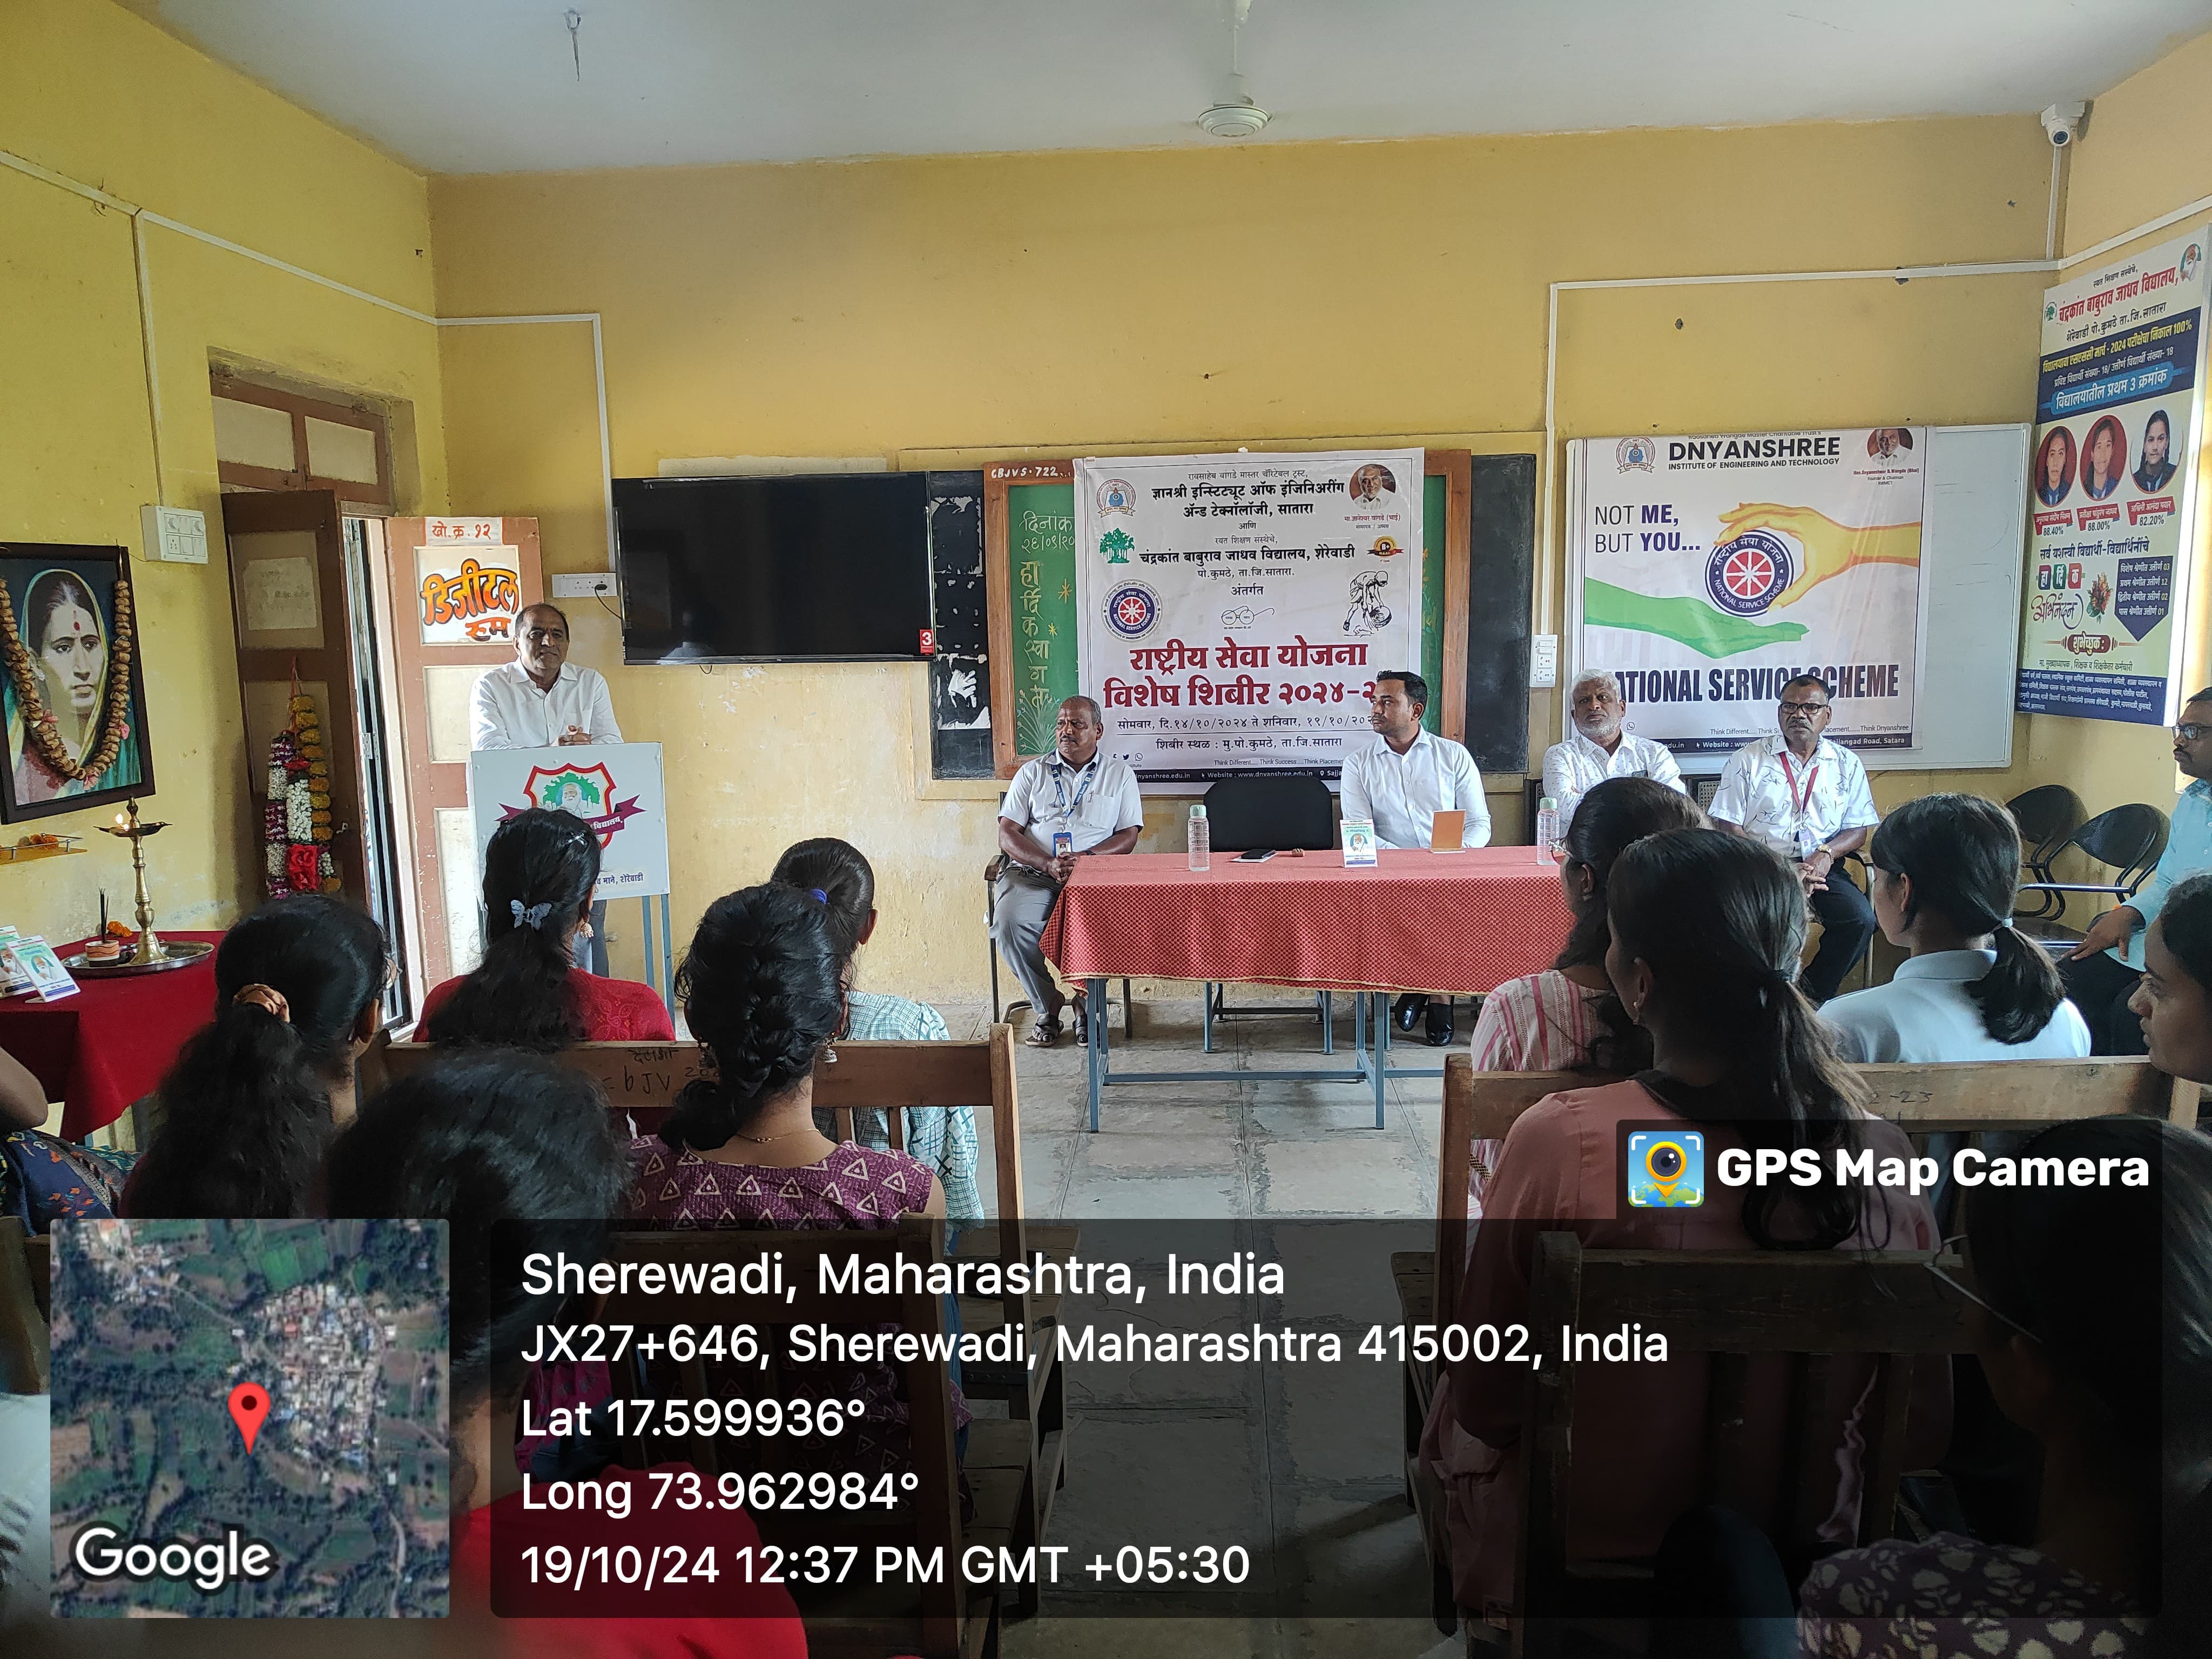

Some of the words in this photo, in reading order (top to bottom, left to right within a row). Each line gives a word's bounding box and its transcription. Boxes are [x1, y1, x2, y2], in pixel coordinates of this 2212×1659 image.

[2059, 295, 2085, 322] चंद्रकांत
[2087, 289, 2114, 316] बाबुराव
[2116, 280, 2139, 301] जाधव
[2141, 267, 2178, 294] विद्यालय,
[2067, 324, 2089, 341] शेरेवाडी
[2070, 346, 2094, 365] एसएससी
[2094, 342, 2106, 357] मार्च
[2110, 339, 2126, 353] 2024
[2150, 325, 2173, 341] निकाल
[2174, 318, 2191, 334] 100%
[2167, 347, 2173, 356] 18
[2056, 383, 2106, 409] विद्यालयातील
[2107, 380, 2128, 396] प्रथम
[2130, 377, 2135, 390] 3
[2139, 367, 2168, 388] क्रमांक
[1669, 436, 1840, 461] DNYANSHREE
[1188, 472, 1216, 480] रावसाहेब
[1292, 470, 1307, 478] ट्रस्ट,
[1152, 484, 1187, 500] ज्ञानश्री
[1191, 482, 1245, 500] इन्स्टिट्यूट
[1250, 481, 1276, 495] ऑफ
[1280, 479, 1345, 497] इंजिनिअरींग
[1211, 501, 1272, 517] टेक्नॉलॉजी,
[1277, 504, 1313, 515] सातारा
[1596, 505, 1634, 525] NOT
[1642, 504, 1678, 526] ME,
[1019, 510, 1075, 535] दिनांक
[1239, 521, 1256, 529] आणि
[2088, 521, 2109, 531] 88.00%
[2140, 514, 2164, 525] 82.20%
[475, 523, 491, 539] १२
[1231, 535, 1251, 544] शिक्षण
[1254, 534, 1277, 543] संस्थेचे,
[2044, 526, 2063, 536] 88.40%
[1596, 534, 1633, 552] BUT
[1640, 532, 1700, 551] YOU...
[1740, 536, 1759, 548] सेवा
[1762, 541, 1783, 564] योजना
[1139, 549, 1179, 565] चंद्रकांत
[1183, 551, 1221, 567] बाबुराव
[1225, 550, 1257, 561] जाधव
[1260, 545, 1310, 561] विद्यालय,
[1314, 544, 1355, 559] शेरेवाडी
[2040, 544, 2051, 559] सर्व
[1197, 567, 1234, 580] पो.कुमठे,
[420, 558, 519, 626] डिजीटल
[1231, 583, 1264, 595] अंतर्गत
[1714, 579, 1737, 608] NATIONAL
[1737, 599, 1765, 609] SERVICE
[1764, 578, 1785, 601] SCHEME
[1114, 613, 1125, 629] NATIONAL
[1141, 613, 1151, 627] SCHEME
[922, 631, 933, 646] 3
[1130, 638, 1209, 676] राष्ट्रीय
[1216, 636, 1270, 669] सेवा
[1277, 635, 1368, 666] योजना
[2074, 659, 2088, 669] शिक्षक
[2115, 660, 2133, 671] कर्मचारी
[1103, 676, 1181, 708] विशेष
[1188, 675, 1270, 705] शिबीर
[1279, 682, 1375, 704] २०२४-२
[1615, 670, 1702, 703] ATIONAL
[1709, 666, 1802, 702] SERVIC
[1809, 664, 1899, 699] CHEME
[1117, 718, 1154, 730] सोमवार,
[1159, 718, 1247, 730] दि.१४/१०/२०२४
[1251, 716, 1258, 726] ते
[1263, 716, 1300, 727] शनिवार,
[1307, 715, 1371, 727] १९/१०/२०२
[1877, 724, 1909, 732] Dnyanshree
[1156, 738, 1183, 750] शिबीर
[1187, 740, 1210, 749] स्थळ
[1222, 736, 1276, 751] मु.पो.कुमठे,
[1281, 736, 1341, 747] ता.जि.सातारा
[620, 872, 643, 883] शेरेवाडी
